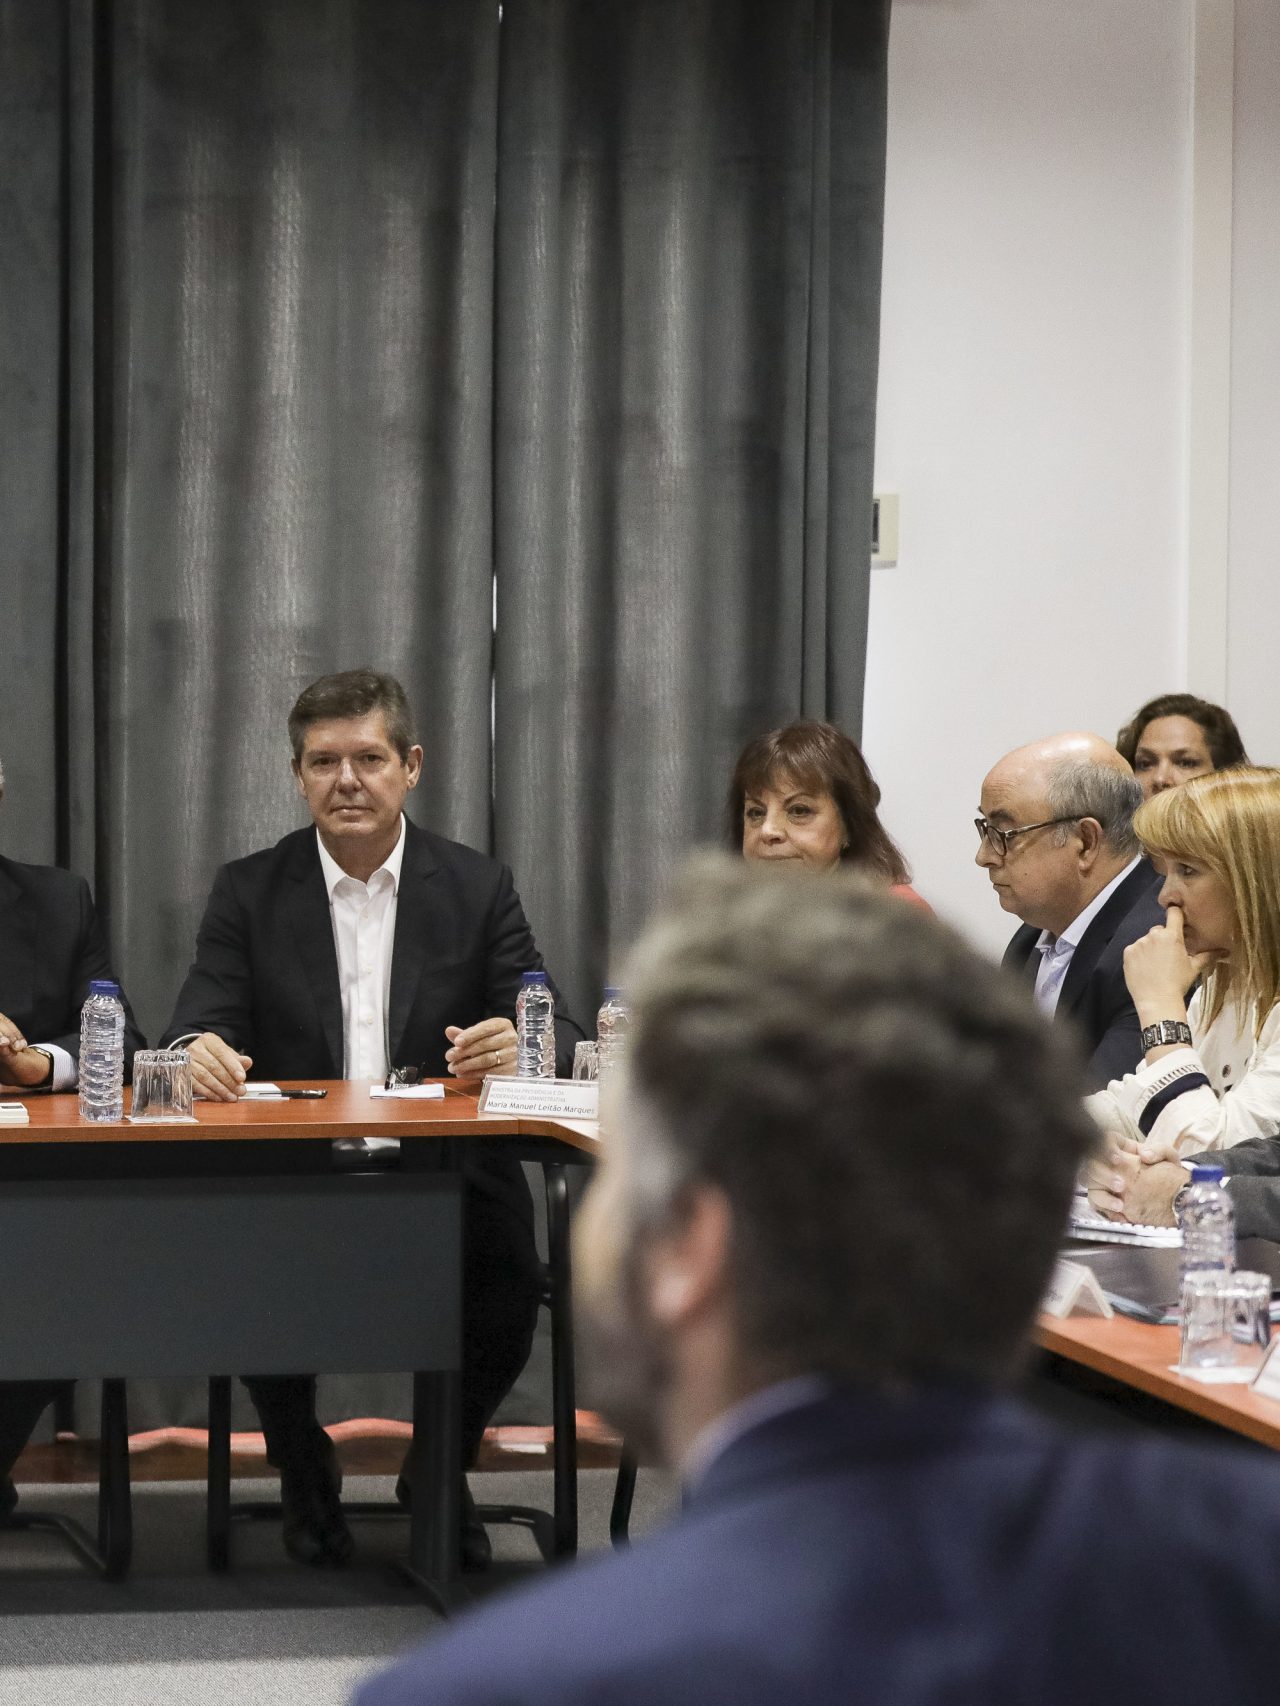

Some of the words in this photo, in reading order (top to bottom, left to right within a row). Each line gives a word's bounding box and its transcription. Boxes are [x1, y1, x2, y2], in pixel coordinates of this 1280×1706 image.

[487, 1101, 507, 1109] Maria
[509, 1102, 536, 1110] Manuel
[538, 1104, 561, 1112] Leitão
[563, 1106, 595, 1115] Marques
